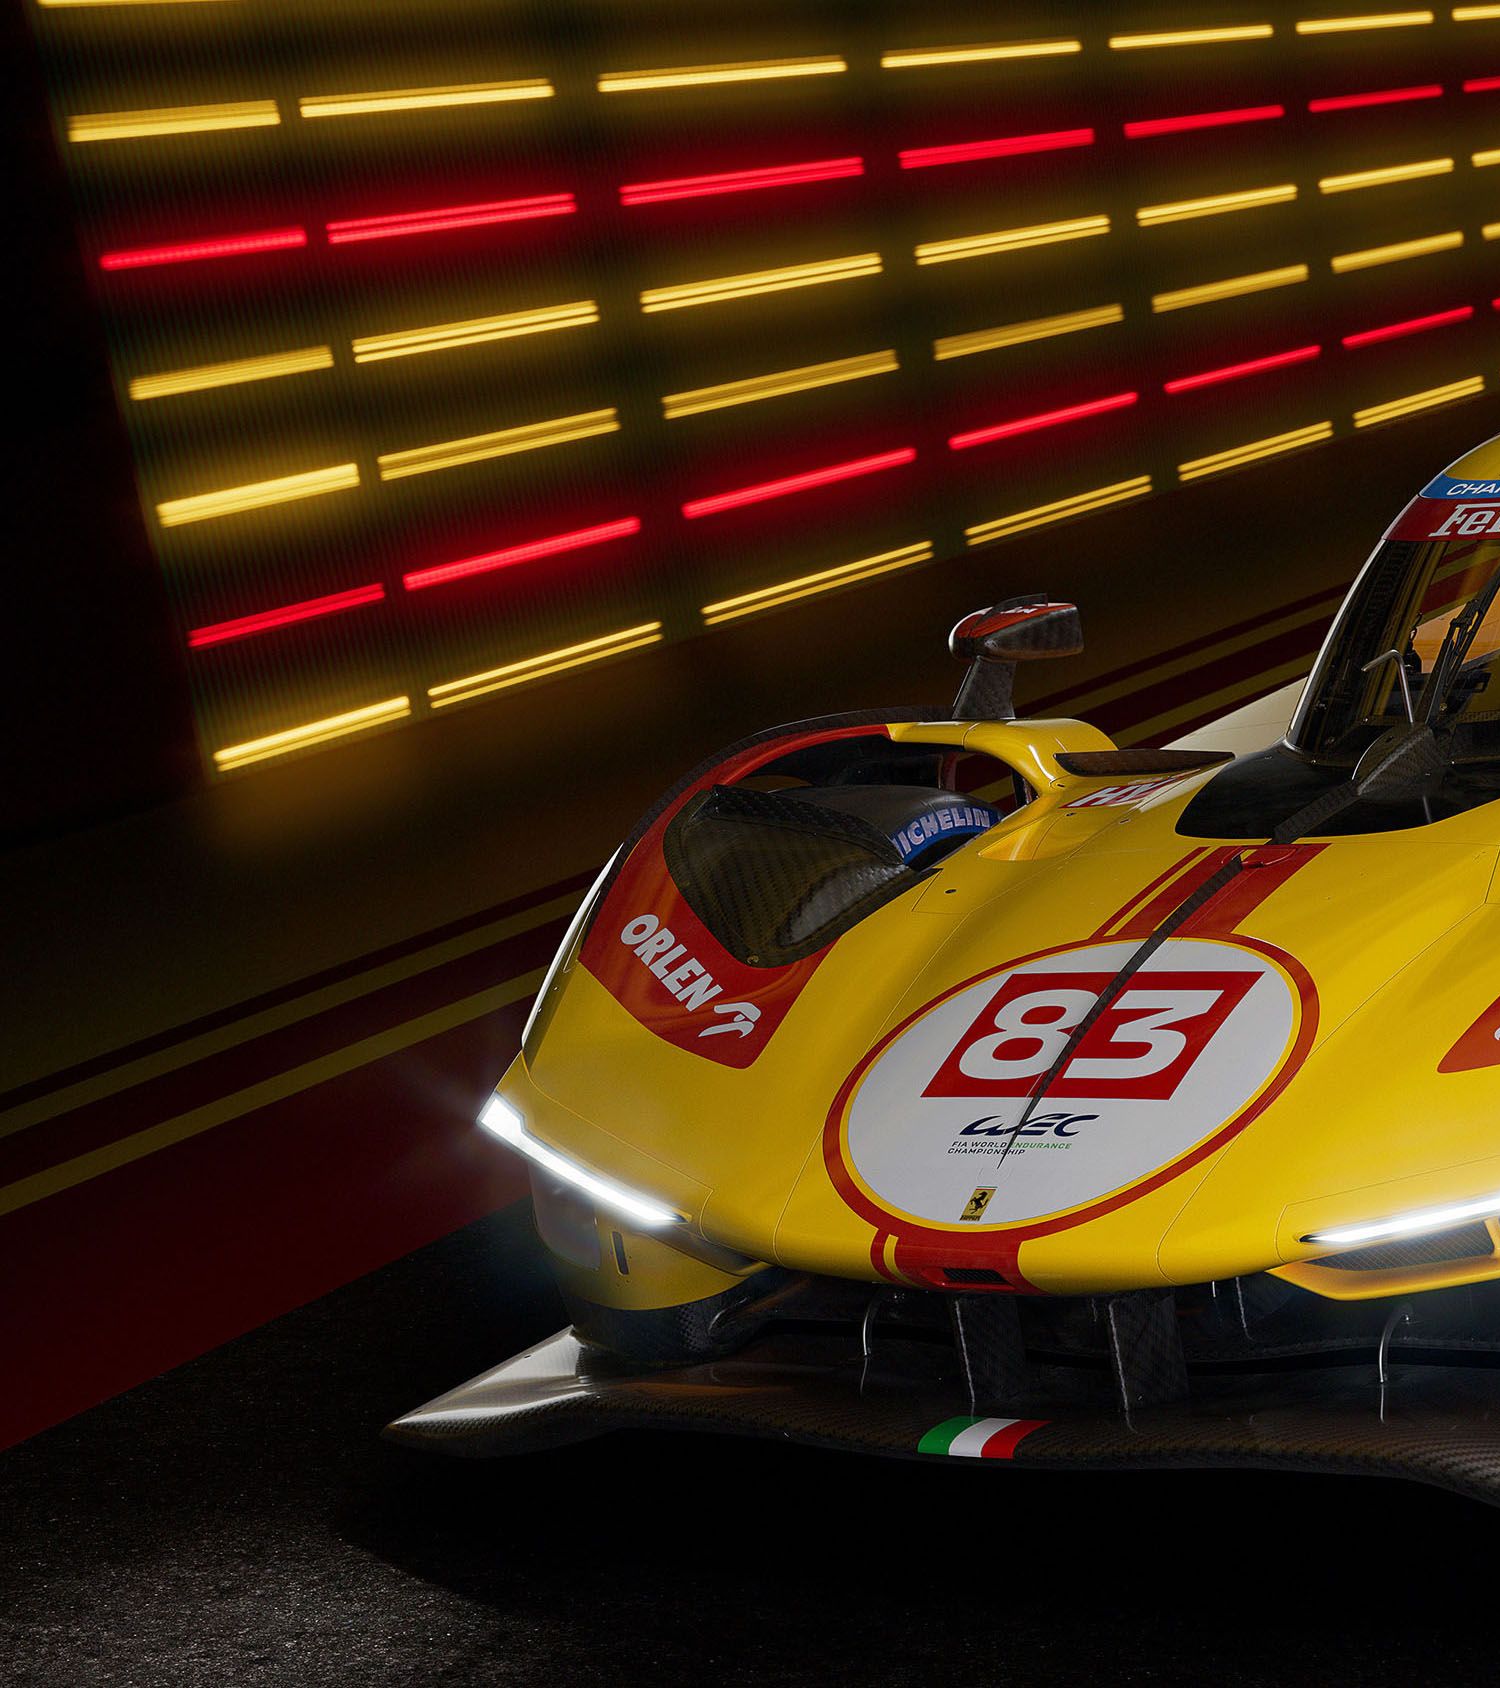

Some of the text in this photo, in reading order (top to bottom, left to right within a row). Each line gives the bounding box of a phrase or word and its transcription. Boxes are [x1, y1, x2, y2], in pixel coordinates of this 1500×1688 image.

[620, 912, 723, 1012] ORLEN
[958, 988, 1226, 1080] 83
[947, 1148, 1026, 1156] CHAMPIONSHIP
[959, 1113, 1100, 1137] WEC
